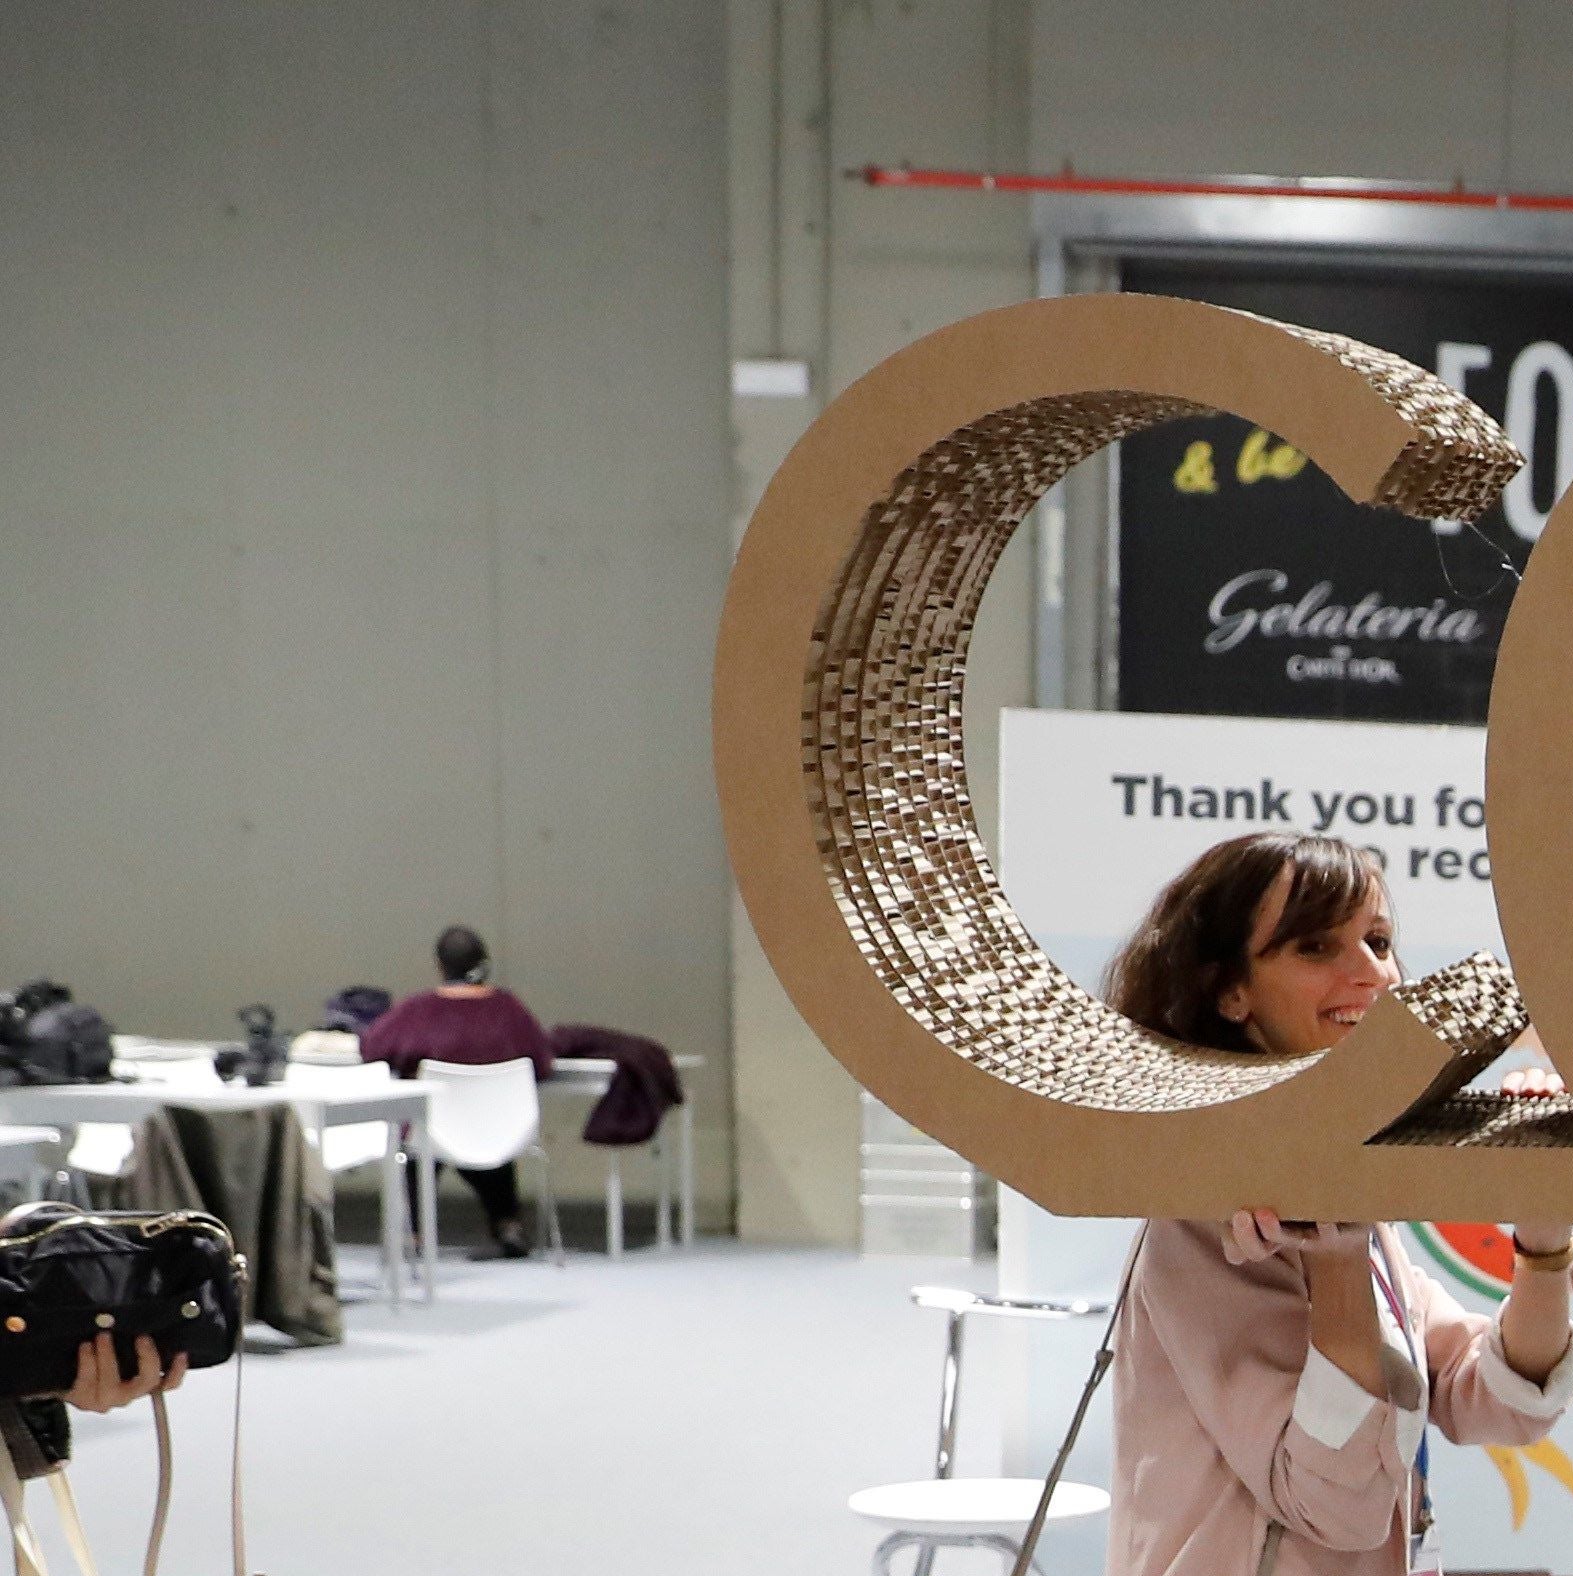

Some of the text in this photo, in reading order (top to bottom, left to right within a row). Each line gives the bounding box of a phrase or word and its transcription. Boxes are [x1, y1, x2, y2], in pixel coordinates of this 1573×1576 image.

[1204, 568, 1484, 655] Gelateria
[1111, 774, 1292, 822] Thank
[1310, 788, 1416, 832] you
[1433, 784, 1487, 829] fo
[1408, 845, 1492, 881] rec
